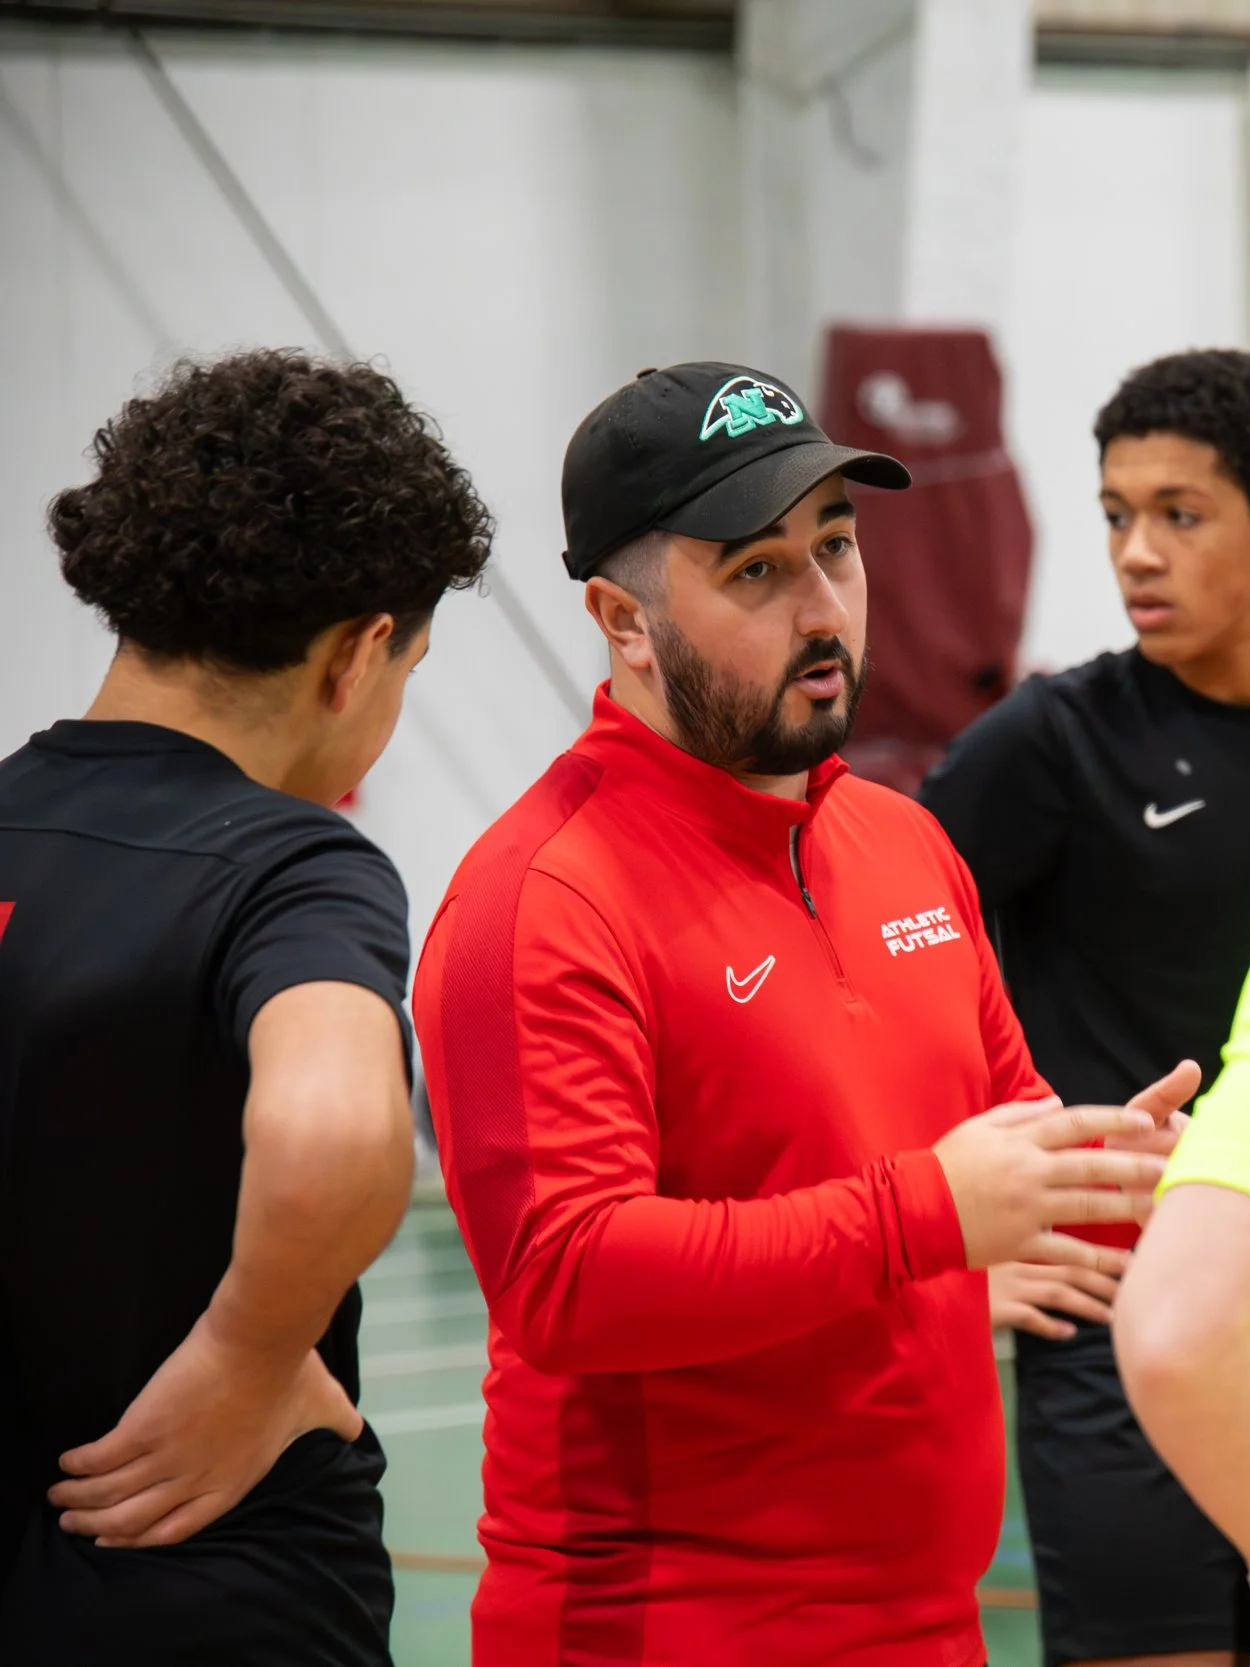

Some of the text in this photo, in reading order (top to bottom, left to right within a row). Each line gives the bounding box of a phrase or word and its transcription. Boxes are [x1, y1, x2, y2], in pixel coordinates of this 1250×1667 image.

[720, 388, 776, 437] N
[881, 906, 951, 939] ATHLETIC
[885, 923, 961, 957] FUTSAL
